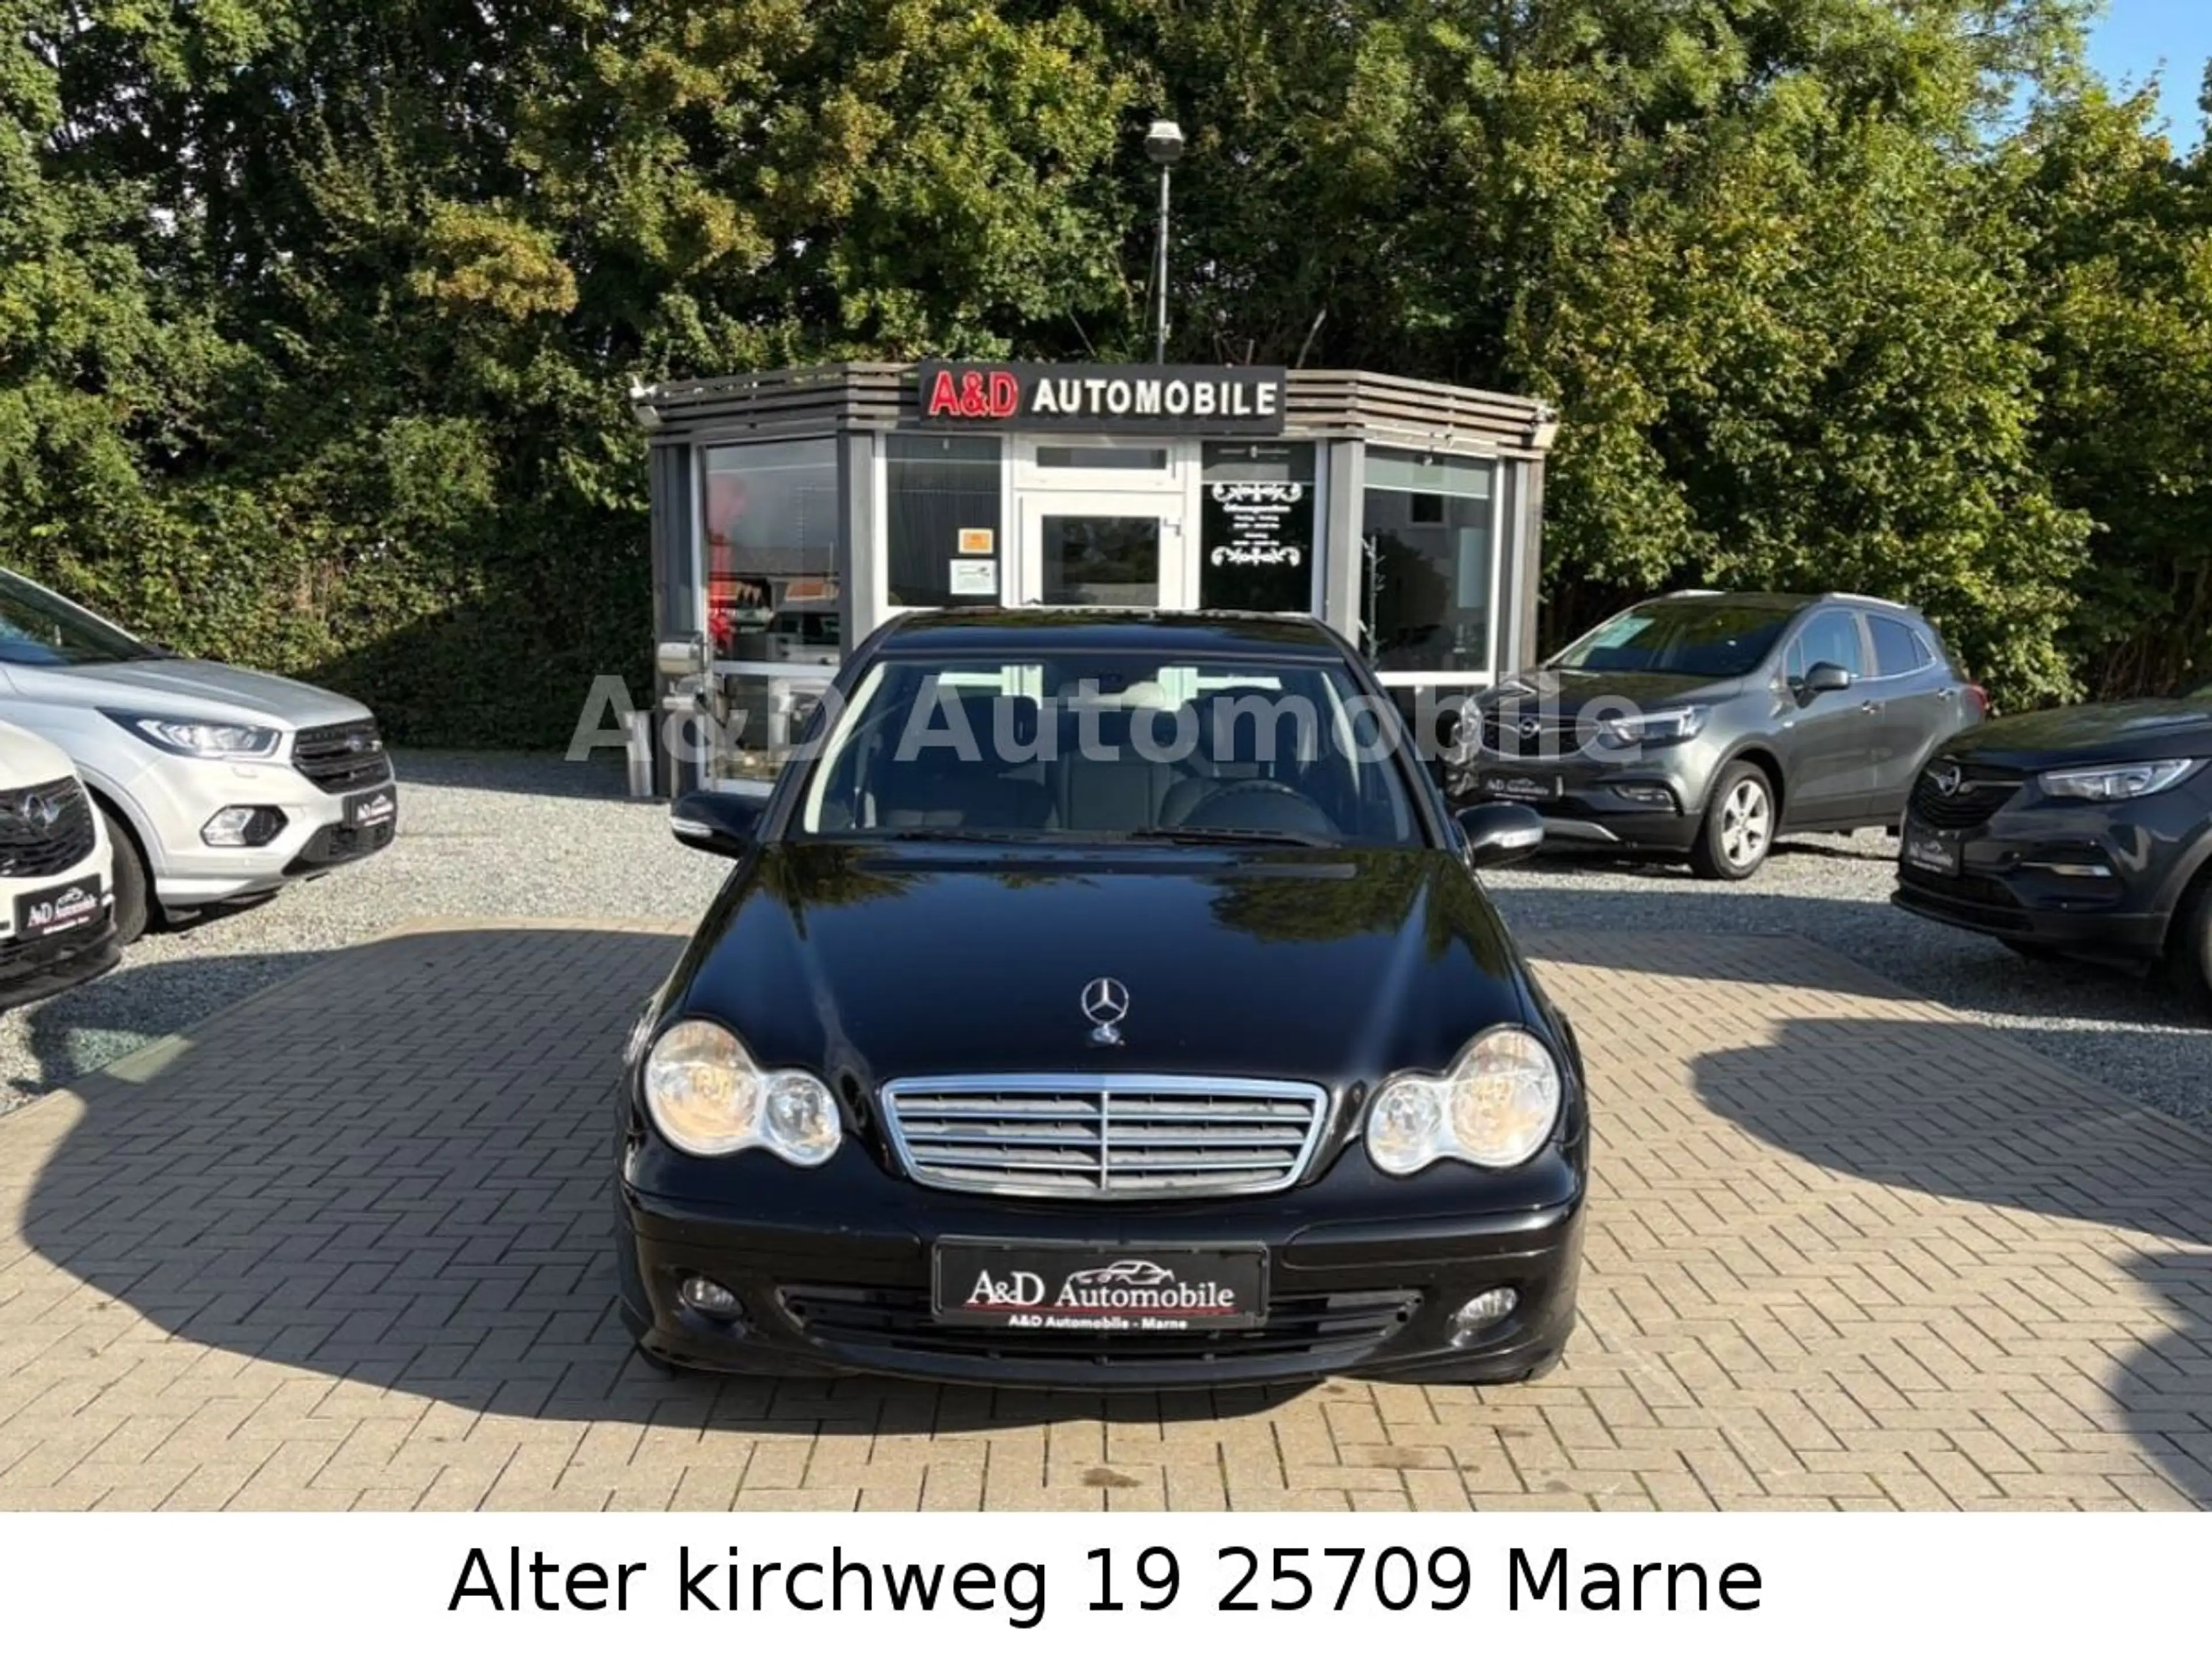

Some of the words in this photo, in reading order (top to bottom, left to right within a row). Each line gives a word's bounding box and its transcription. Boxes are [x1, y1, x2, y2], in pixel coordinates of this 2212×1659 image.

[928, 370, 1019, 418] A&D
[1032, 378, 1278, 415] AUTOMOBILE
[967, 1270, 1046, 1306] A&D
[1054, 1282, 1234, 1308] Automobile
[1009, 1314, 1043, 1327] A&D
[1045, 1315, 1130, 1329] Automobile
[1142, 1317, 1188, 1330] Marne
